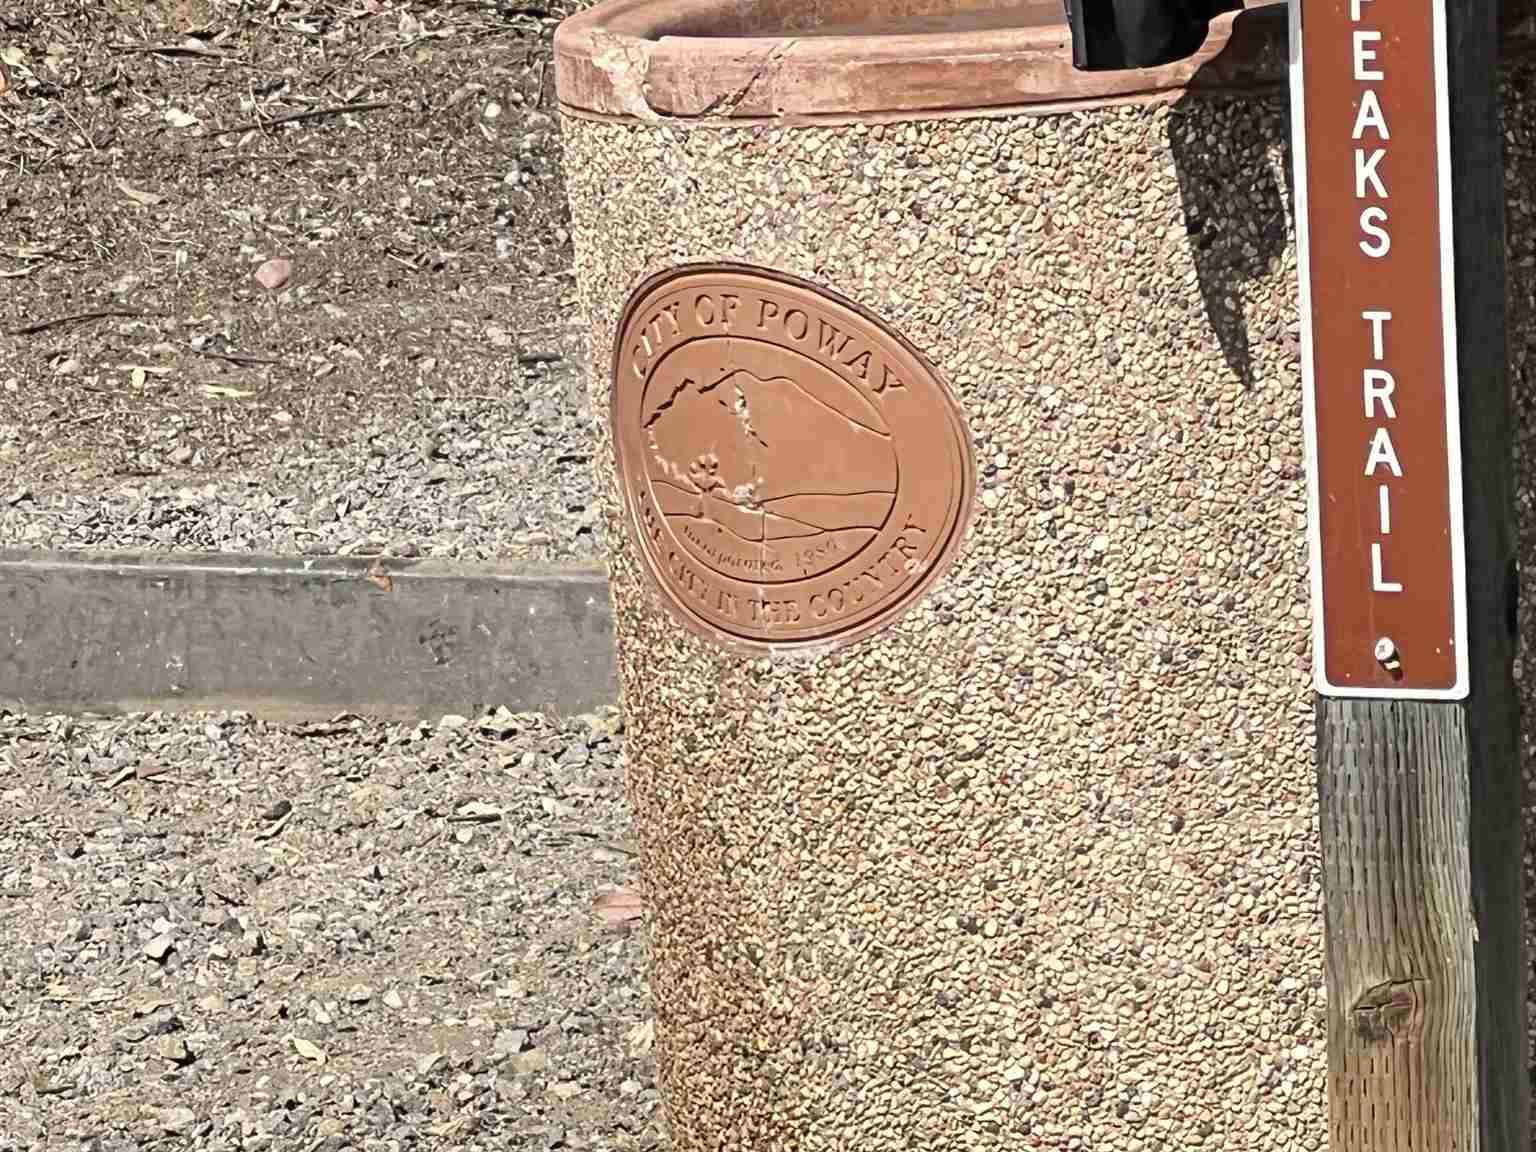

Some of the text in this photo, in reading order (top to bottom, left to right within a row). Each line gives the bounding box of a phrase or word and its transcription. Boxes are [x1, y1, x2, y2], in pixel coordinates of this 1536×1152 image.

[631, 293, 908, 398] CITY OF POWAY
[1361, 310, 1403, 593] TRAIL
